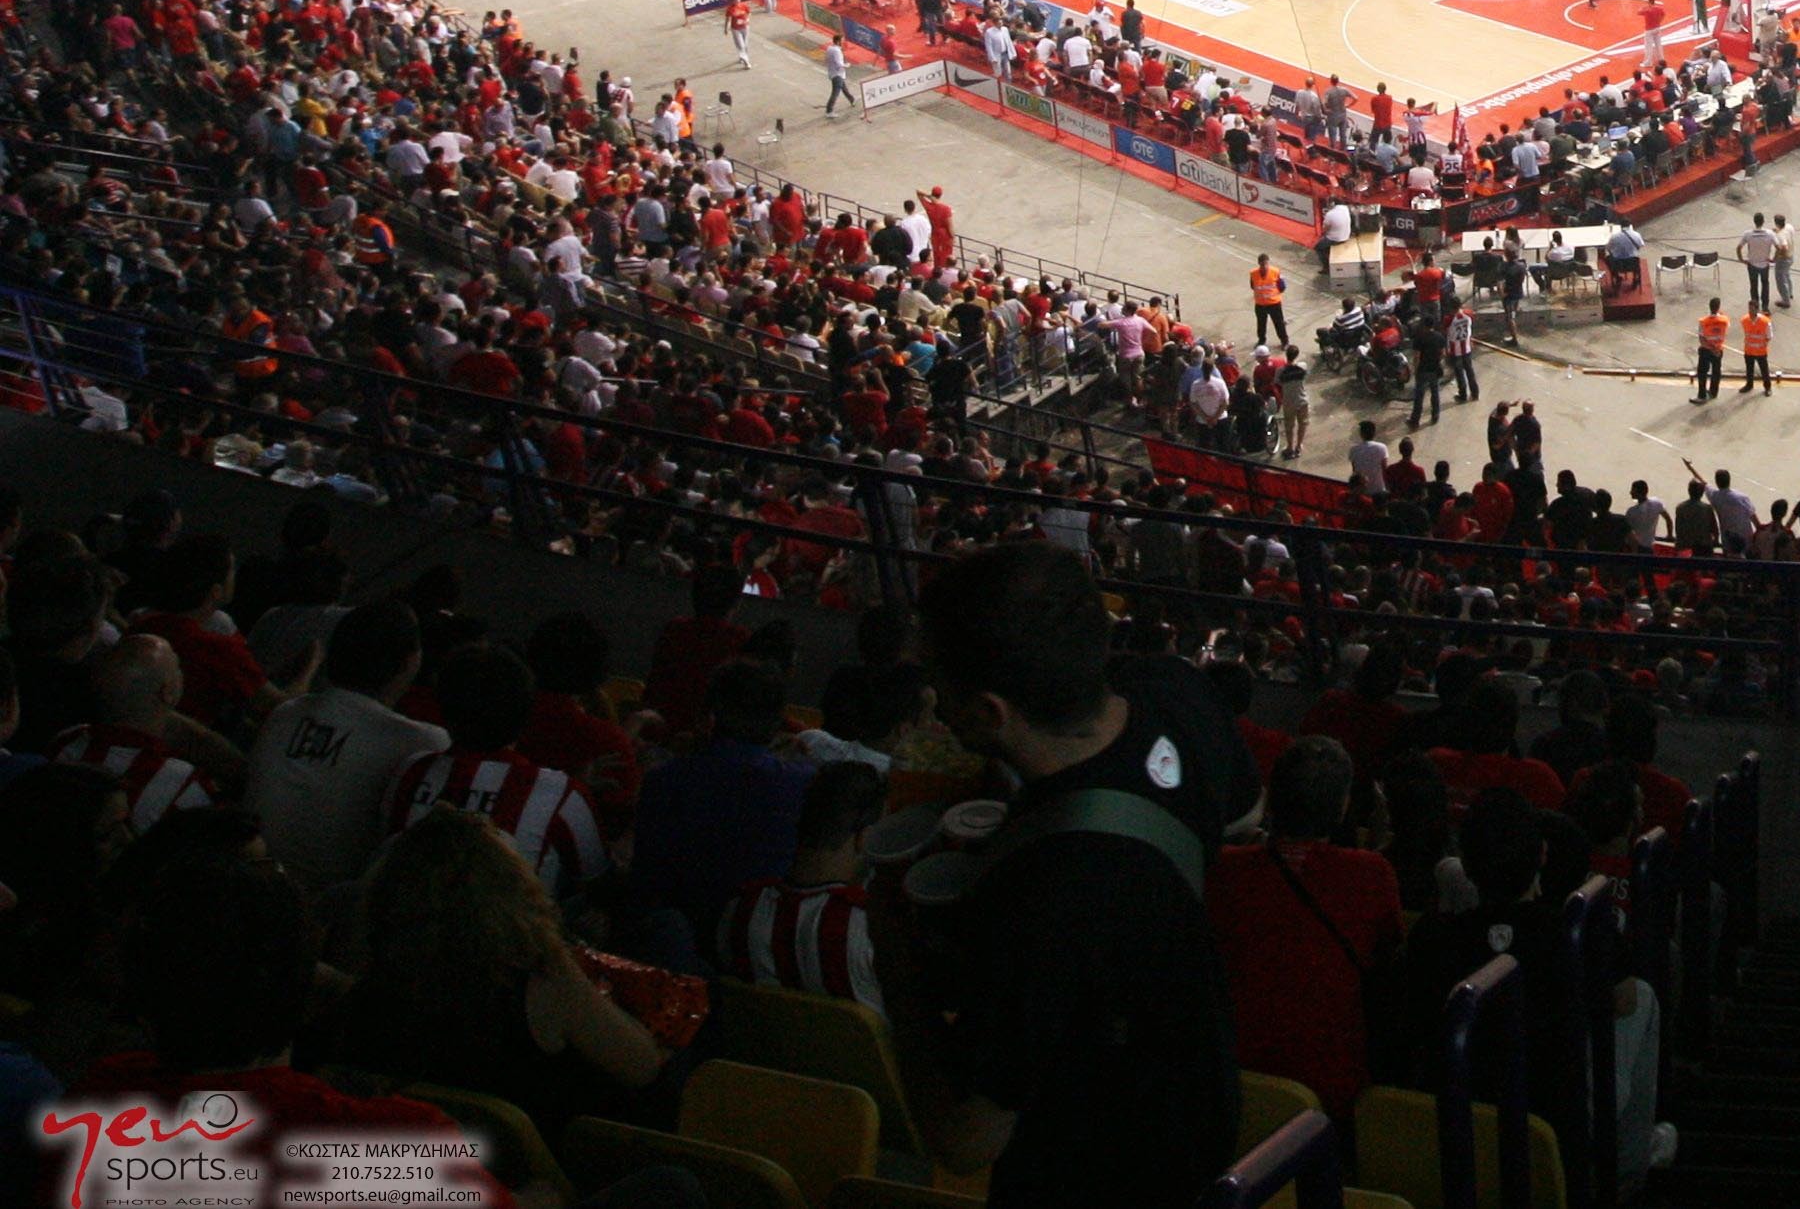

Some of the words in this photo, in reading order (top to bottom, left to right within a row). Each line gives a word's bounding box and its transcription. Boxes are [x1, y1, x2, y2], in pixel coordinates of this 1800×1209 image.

[880, 69, 945, 96] PEUGEOT
[1132, 141, 1154, 159] OTE
[1179, 159, 1235, 197] citibank
